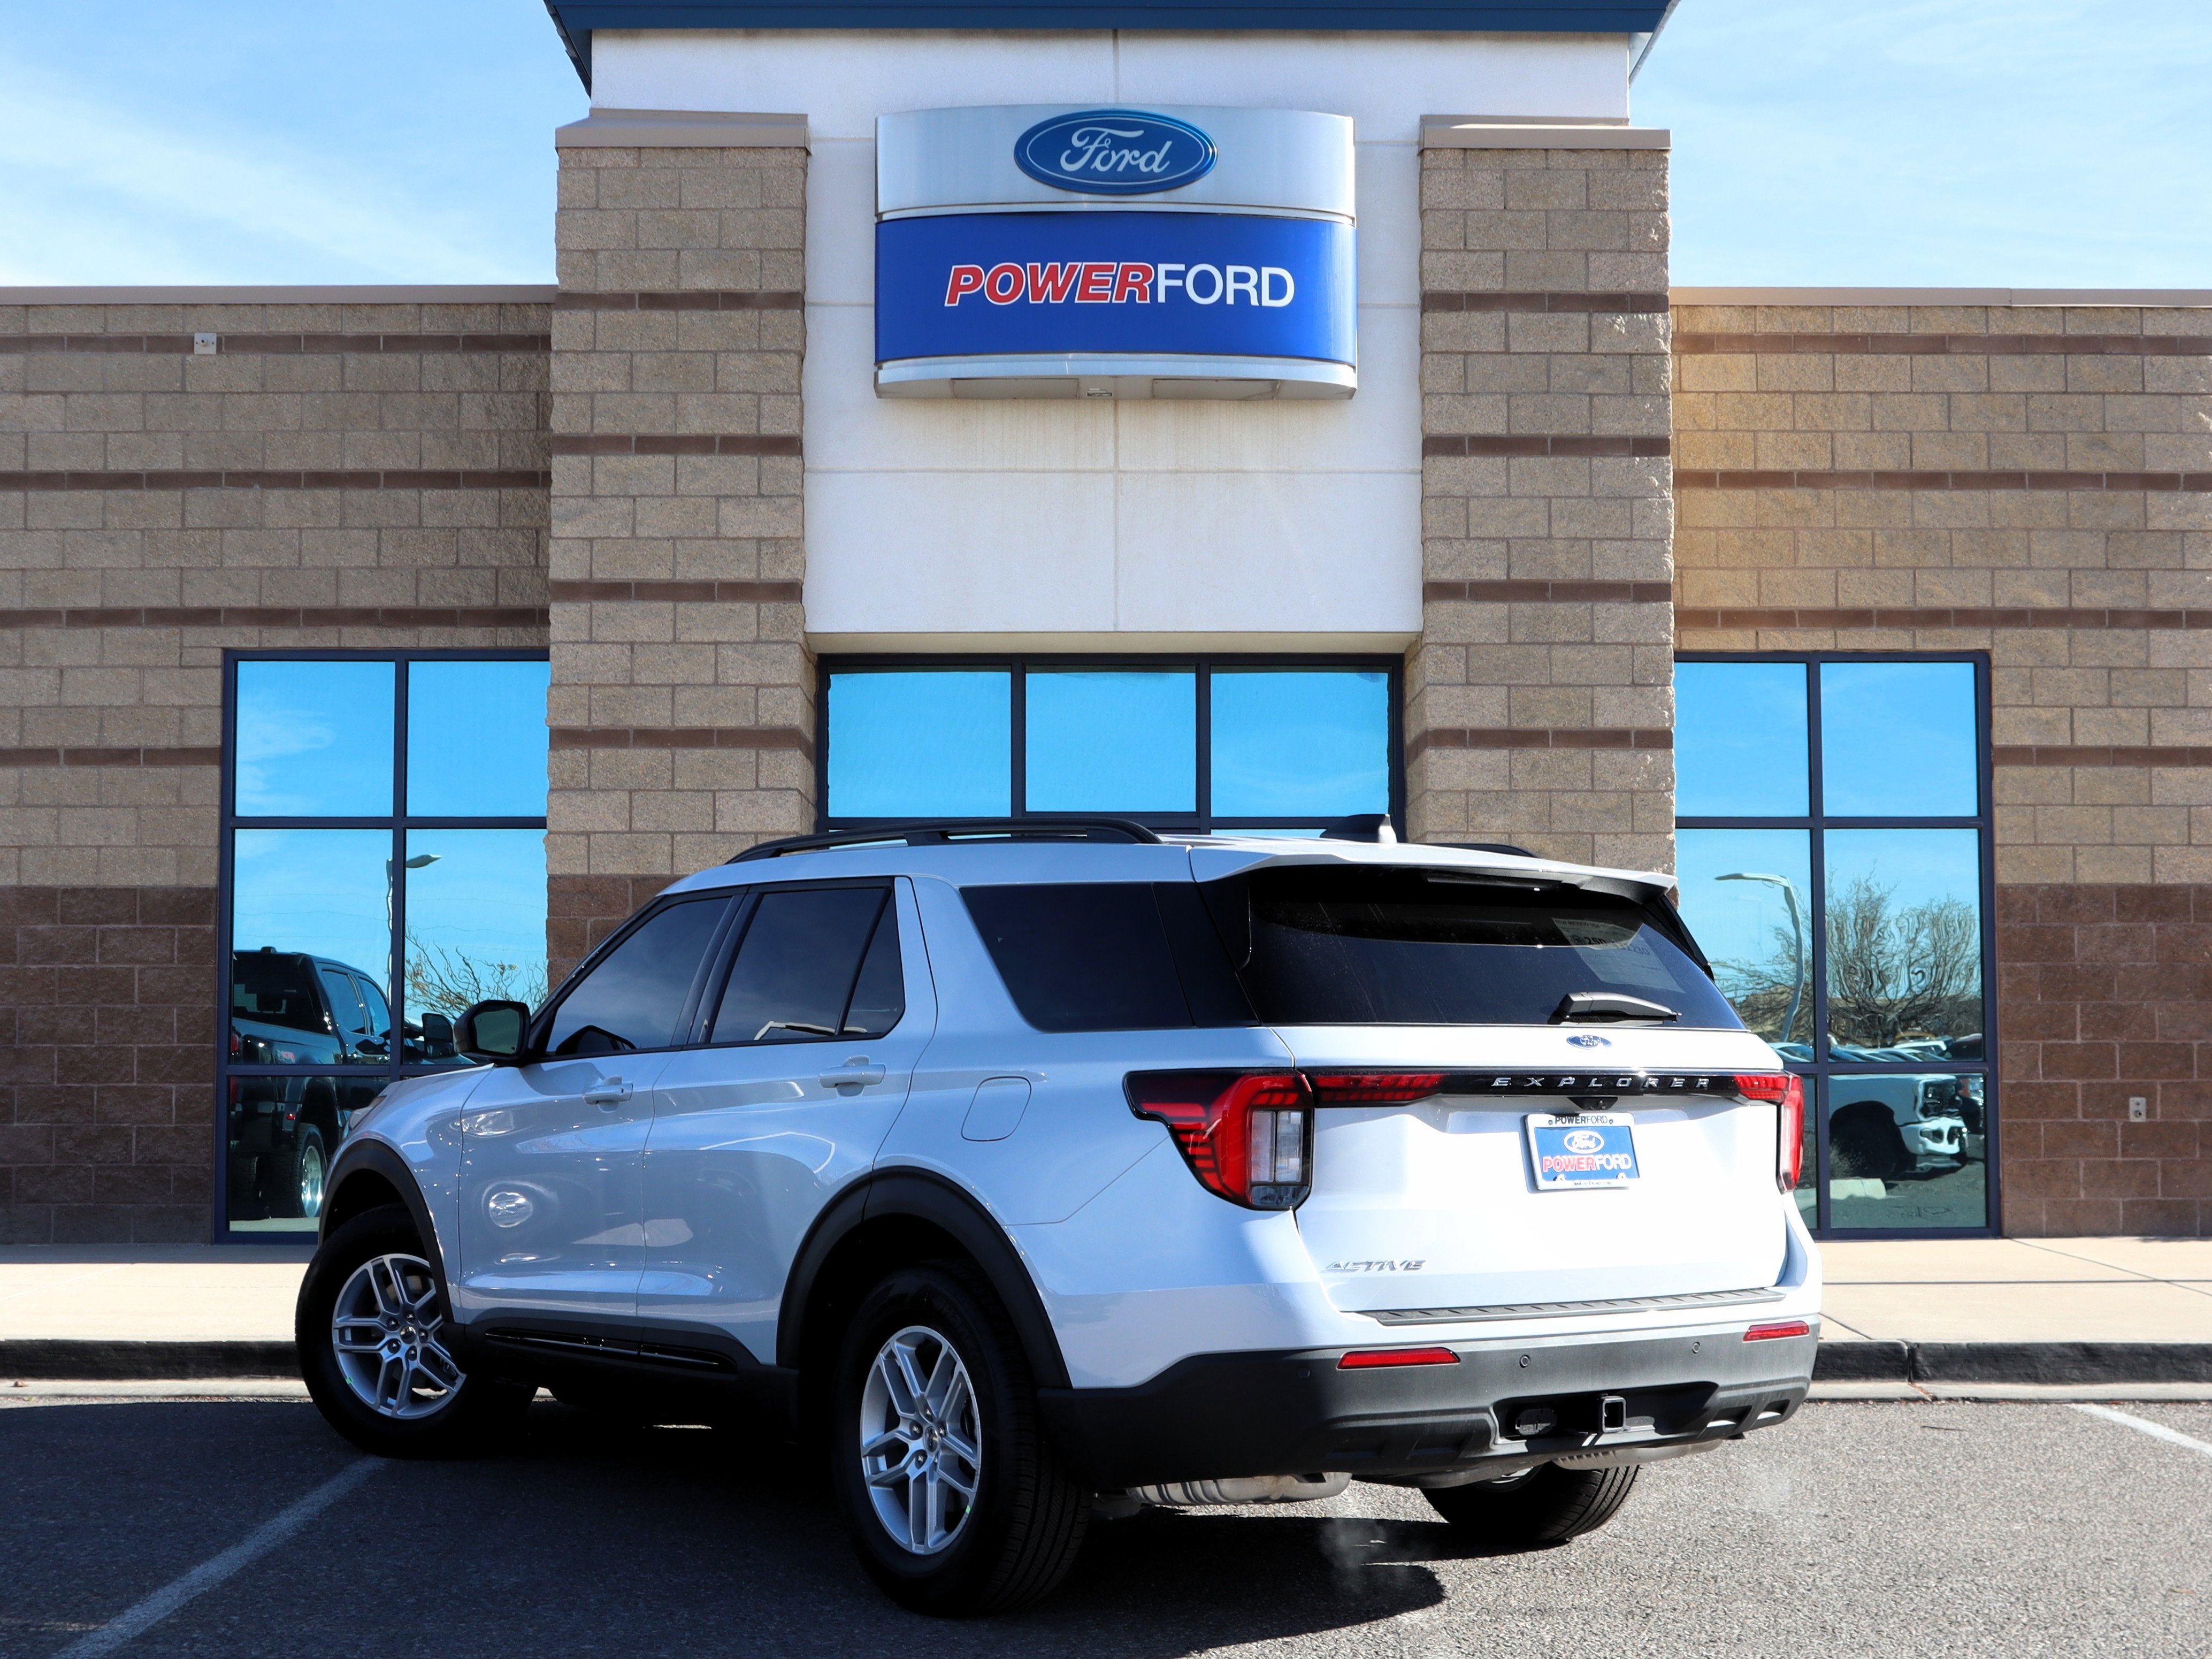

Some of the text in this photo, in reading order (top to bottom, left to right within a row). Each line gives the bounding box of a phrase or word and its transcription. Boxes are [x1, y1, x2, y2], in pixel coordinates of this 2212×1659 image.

[1060, 126, 1173, 173] Ford
[1491, 1076, 1710, 1089] EXPLORER
[1571, 1134, 1596, 1149] Ford
[1326, 1260, 1426, 1272] ACTIVE
